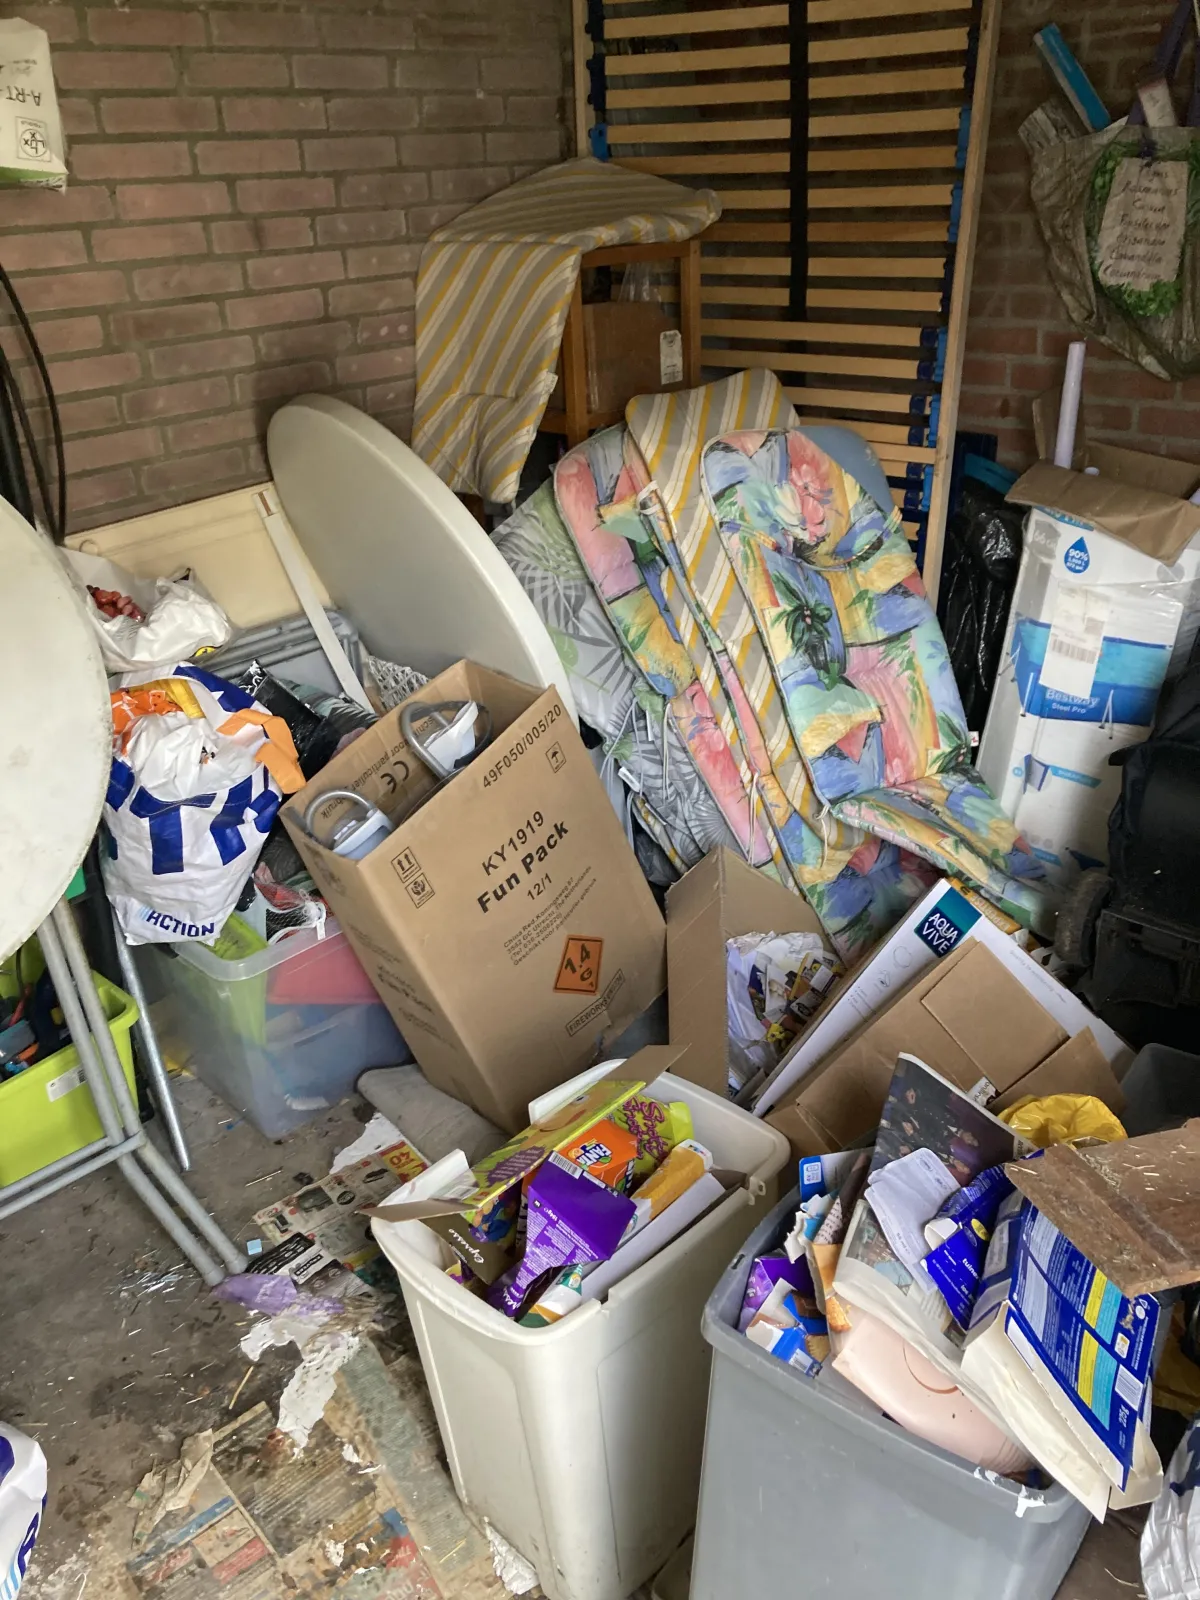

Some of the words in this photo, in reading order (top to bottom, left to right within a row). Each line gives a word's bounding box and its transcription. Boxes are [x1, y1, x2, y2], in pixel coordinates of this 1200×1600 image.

[1068, 548, 1088, 561] 90%
[1052, 702, 1071, 712] Steel
[1072, 706, 1086, 714] Pro
[483, 704, 562, 788] 49F050/005/20
[353, 751, 391, 791] particulier
[481, 811, 544, 876] KY1919
[477, 872, 521, 914] Fun
[521, 821, 569, 875] Pack
[527, 873, 552, 900] 12/1
[522, 930, 533, 941] GC
[564, 866, 592, 900] Netherlands
[145, 910, 215, 938] ACTION
[503, 931, 522, 948] China
[513, 940, 542, 966] Geschikt
[555, 899, 580, 931] particulier
[922, 922, 950, 954] VIVE
[928, 913, 958, 943] AQUA
[564, 943, 591, 974] 1.4
[580, 967, 593, 982] G
[568, 998, 608, 1033] FIREWORKS
[576, 1143, 612, 1166] FANTA
